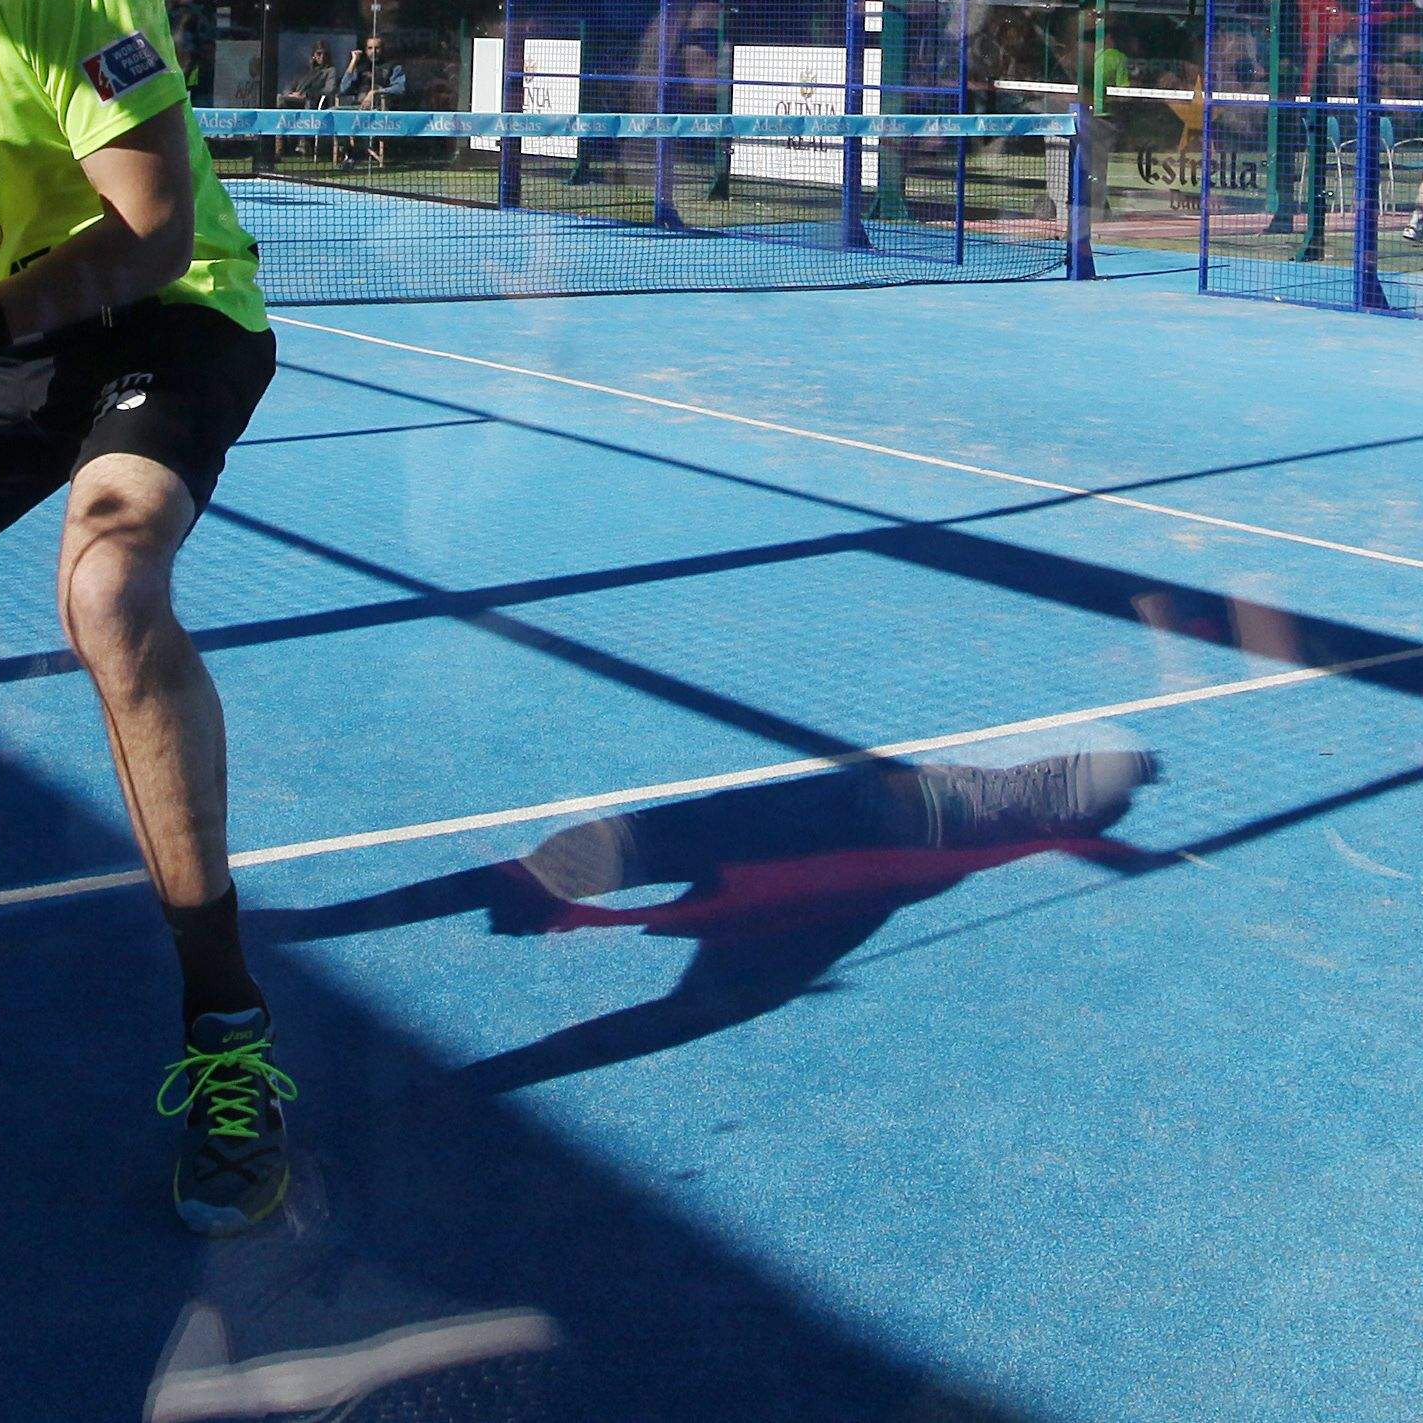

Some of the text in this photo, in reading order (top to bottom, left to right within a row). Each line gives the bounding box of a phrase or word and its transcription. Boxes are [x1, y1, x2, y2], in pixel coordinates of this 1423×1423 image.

[129, 58, 155, 75] TOUR
[199, 112, 252, 129] Adeslas
[352, 113, 402, 130] Adeslas
[494, 115, 542, 132] Adeslas
